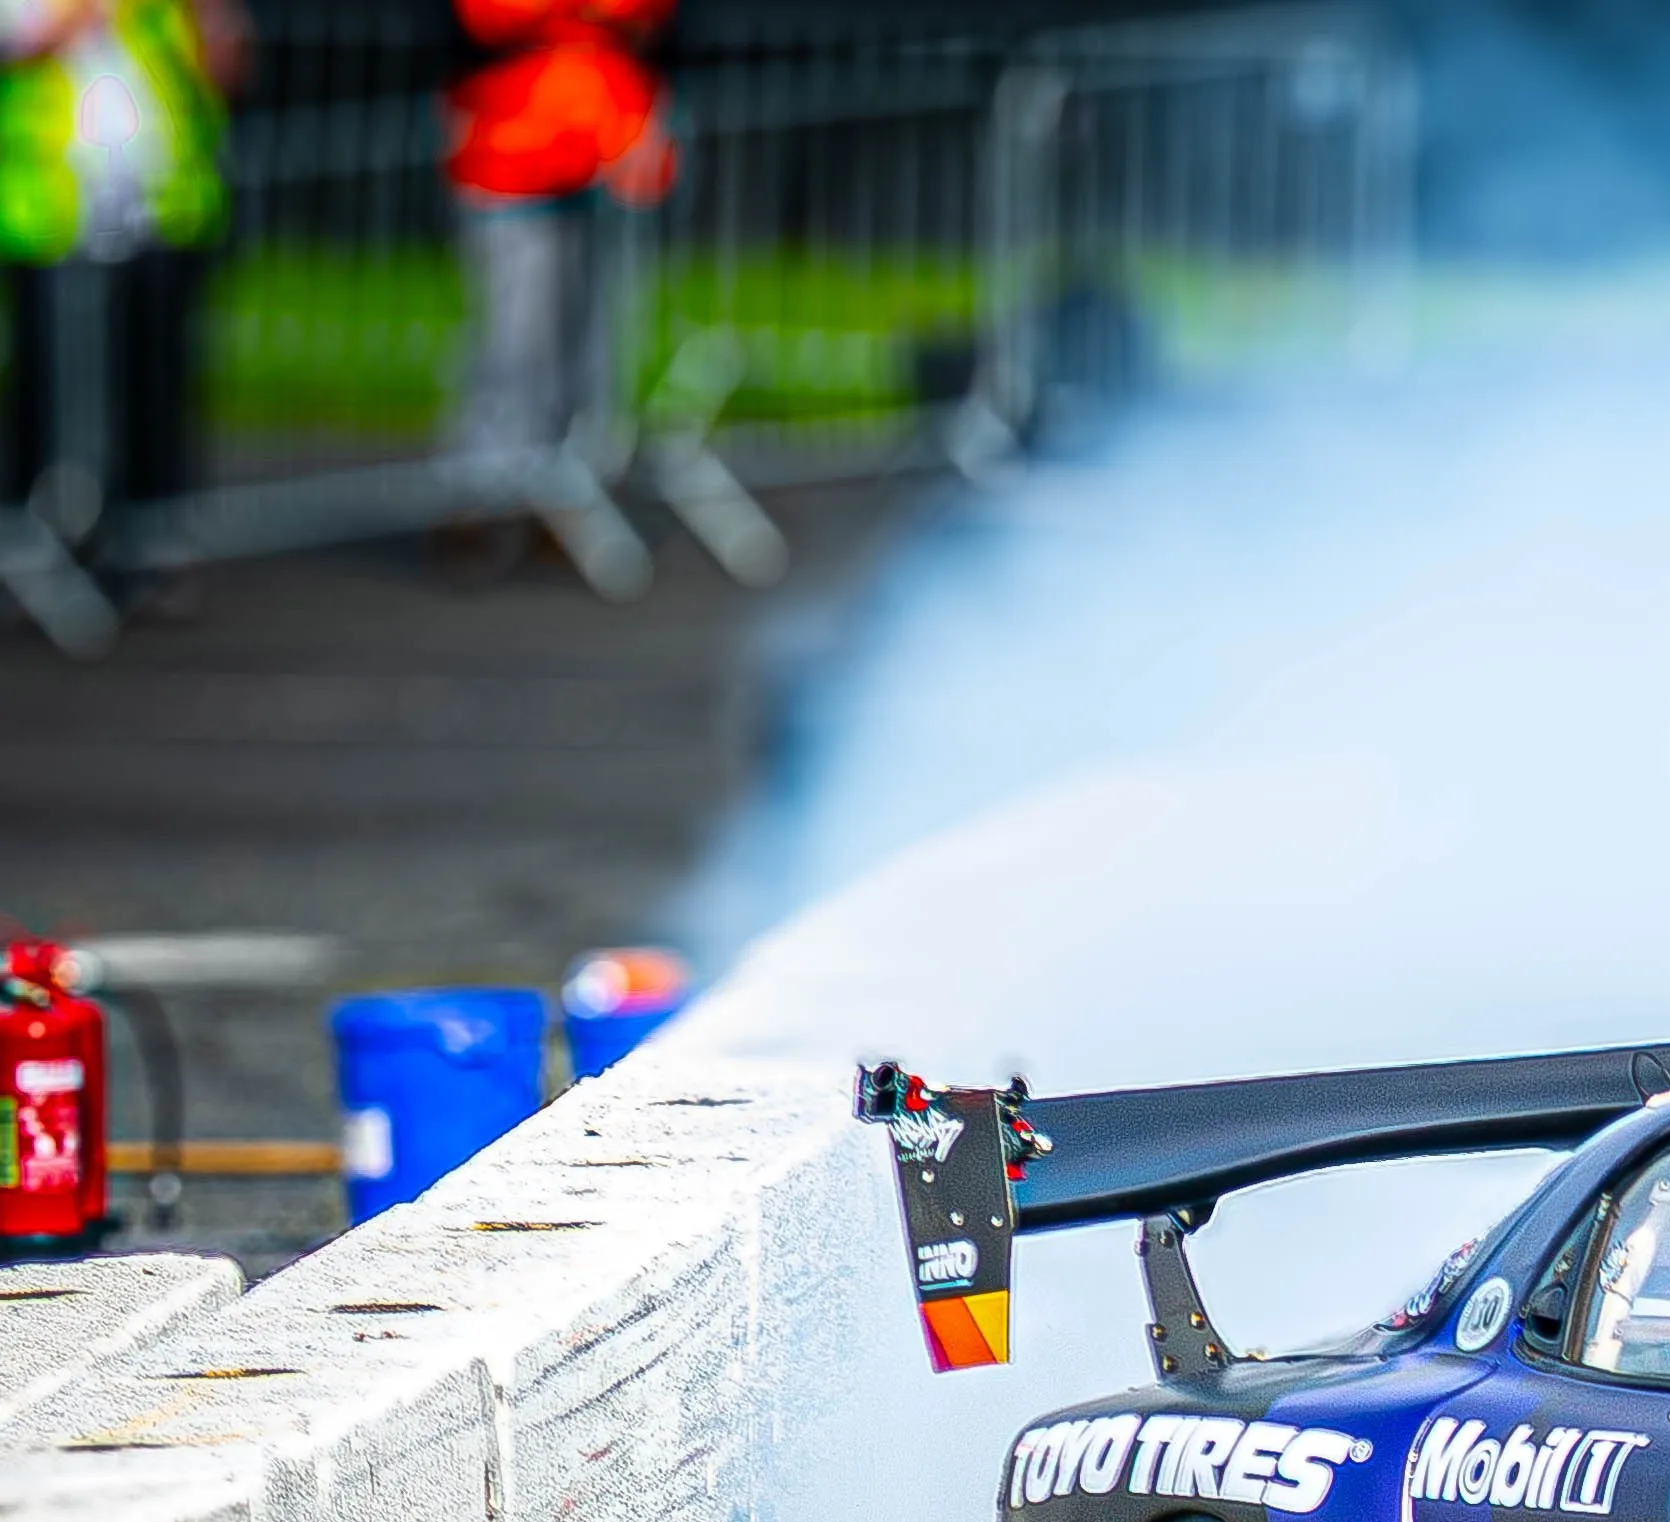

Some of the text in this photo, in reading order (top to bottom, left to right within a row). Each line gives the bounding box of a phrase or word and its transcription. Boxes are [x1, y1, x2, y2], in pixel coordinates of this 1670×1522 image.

[1011, 1414, 1350, 1513] TOYO TIRES
[1411, 1416, 1575, 1512] Mobil
